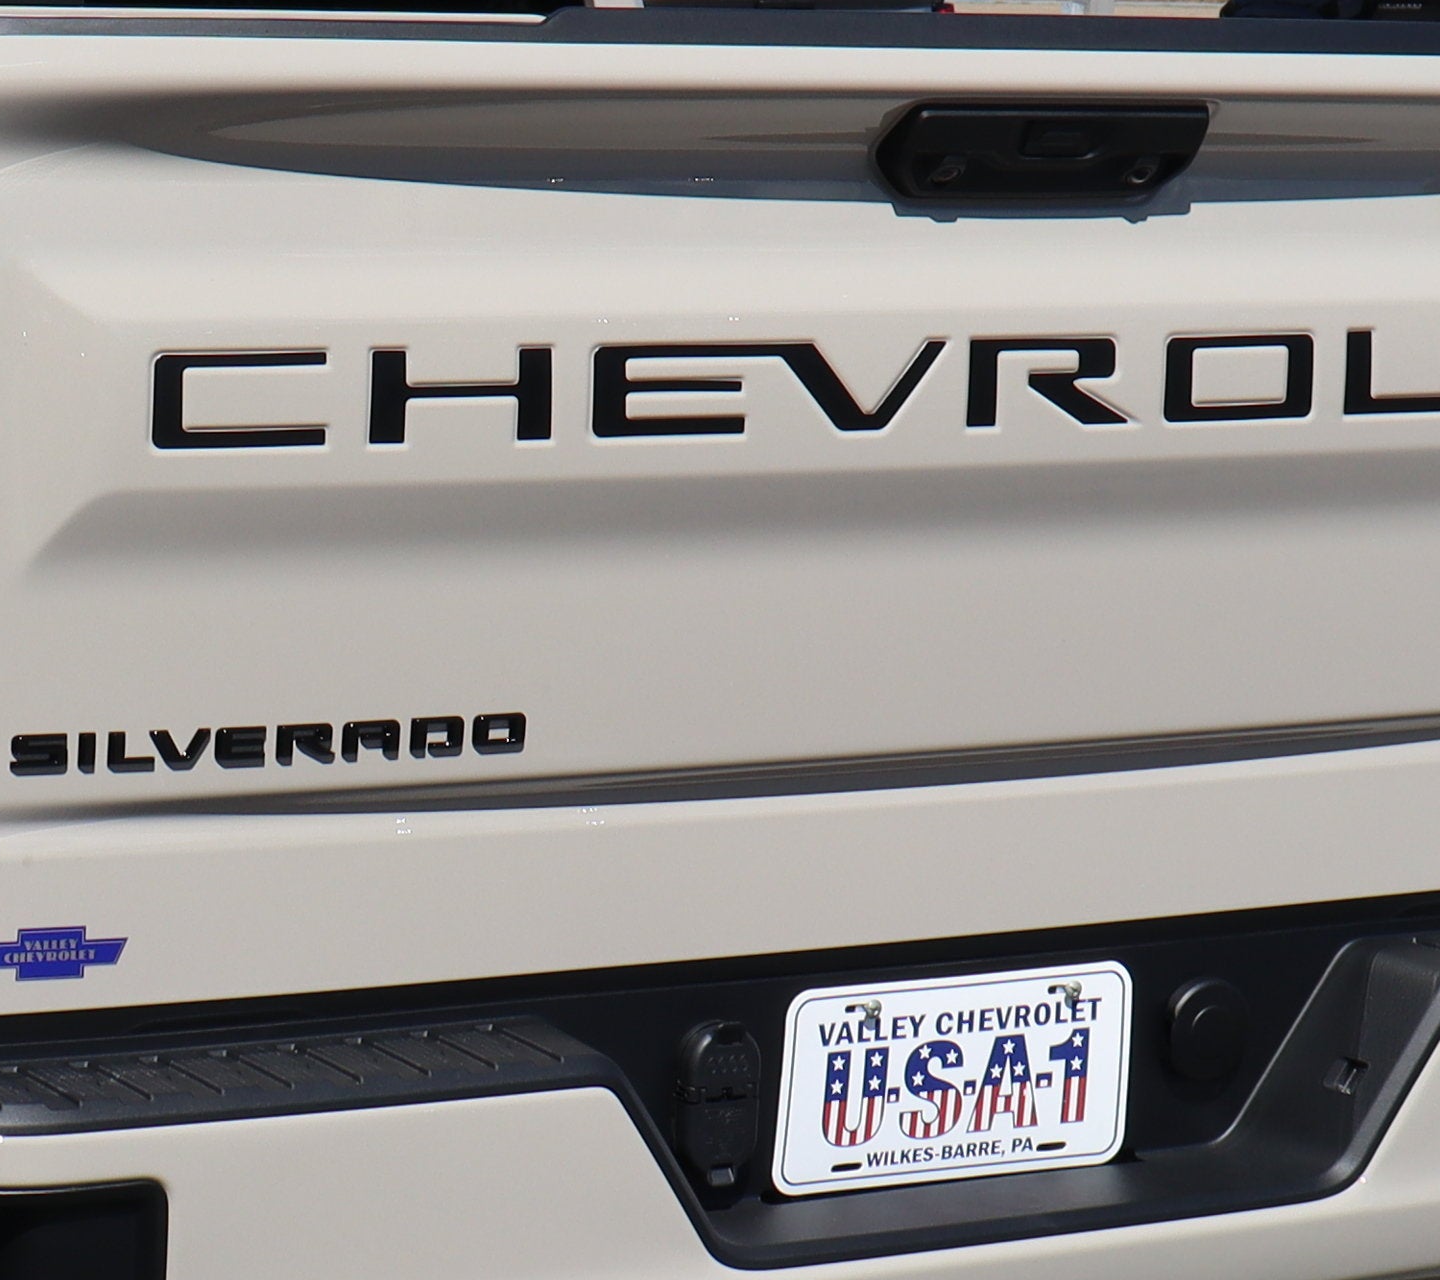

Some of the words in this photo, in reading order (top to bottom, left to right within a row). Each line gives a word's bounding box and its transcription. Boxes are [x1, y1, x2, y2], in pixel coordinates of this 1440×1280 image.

[9, 711, 527, 776] SILVERADO
[3, 947, 97, 964] CHEVROLET
[24, 936, 79, 952] VALLEY
[818, 1013, 925, 1047] VALLEY
[935, 997, 1103, 1036] CHEVROLET
[865, 1139, 1007, 1168] WILKES-BARRE,
[1010, 1136, 1034, 1154] PA
